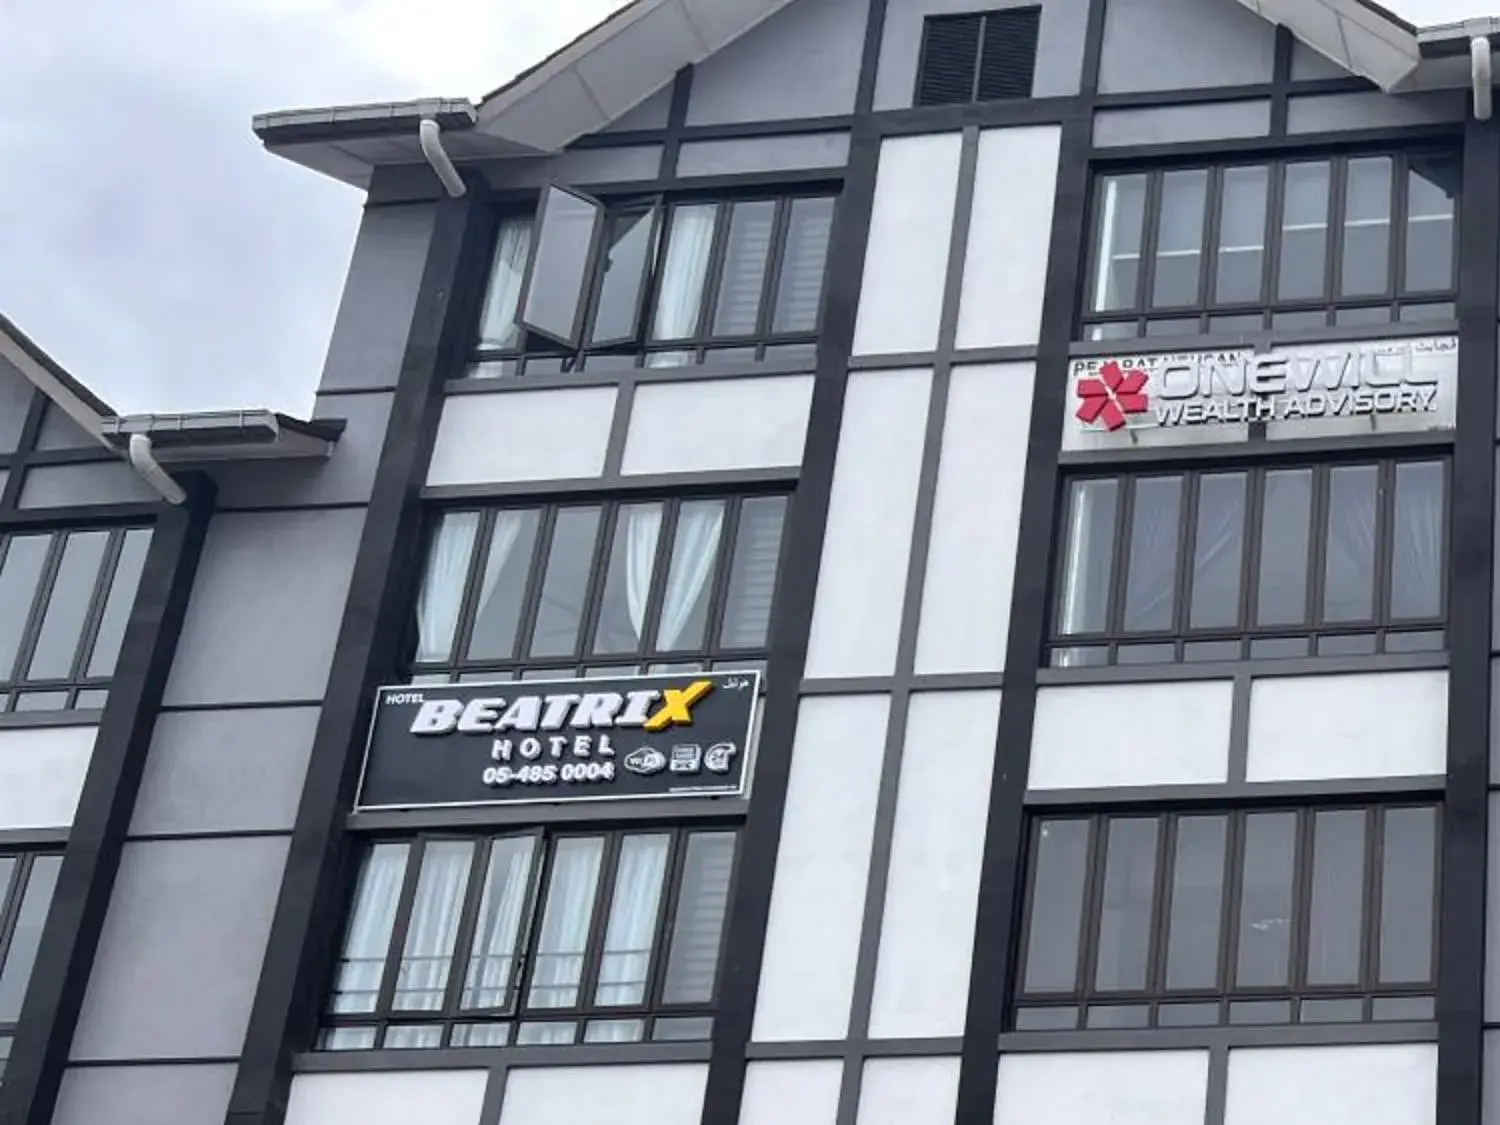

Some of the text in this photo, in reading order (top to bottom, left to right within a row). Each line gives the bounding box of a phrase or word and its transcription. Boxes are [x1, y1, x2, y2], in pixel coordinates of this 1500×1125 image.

[1156, 386, 1438, 426] WEALTH ADVISORY
[385, 692, 425, 705] HOTEL
[410, 680, 713, 734] BEATRIX
[491, 734, 616, 760] HOTEL
[483, 761, 615, 784] 05-485 0004
